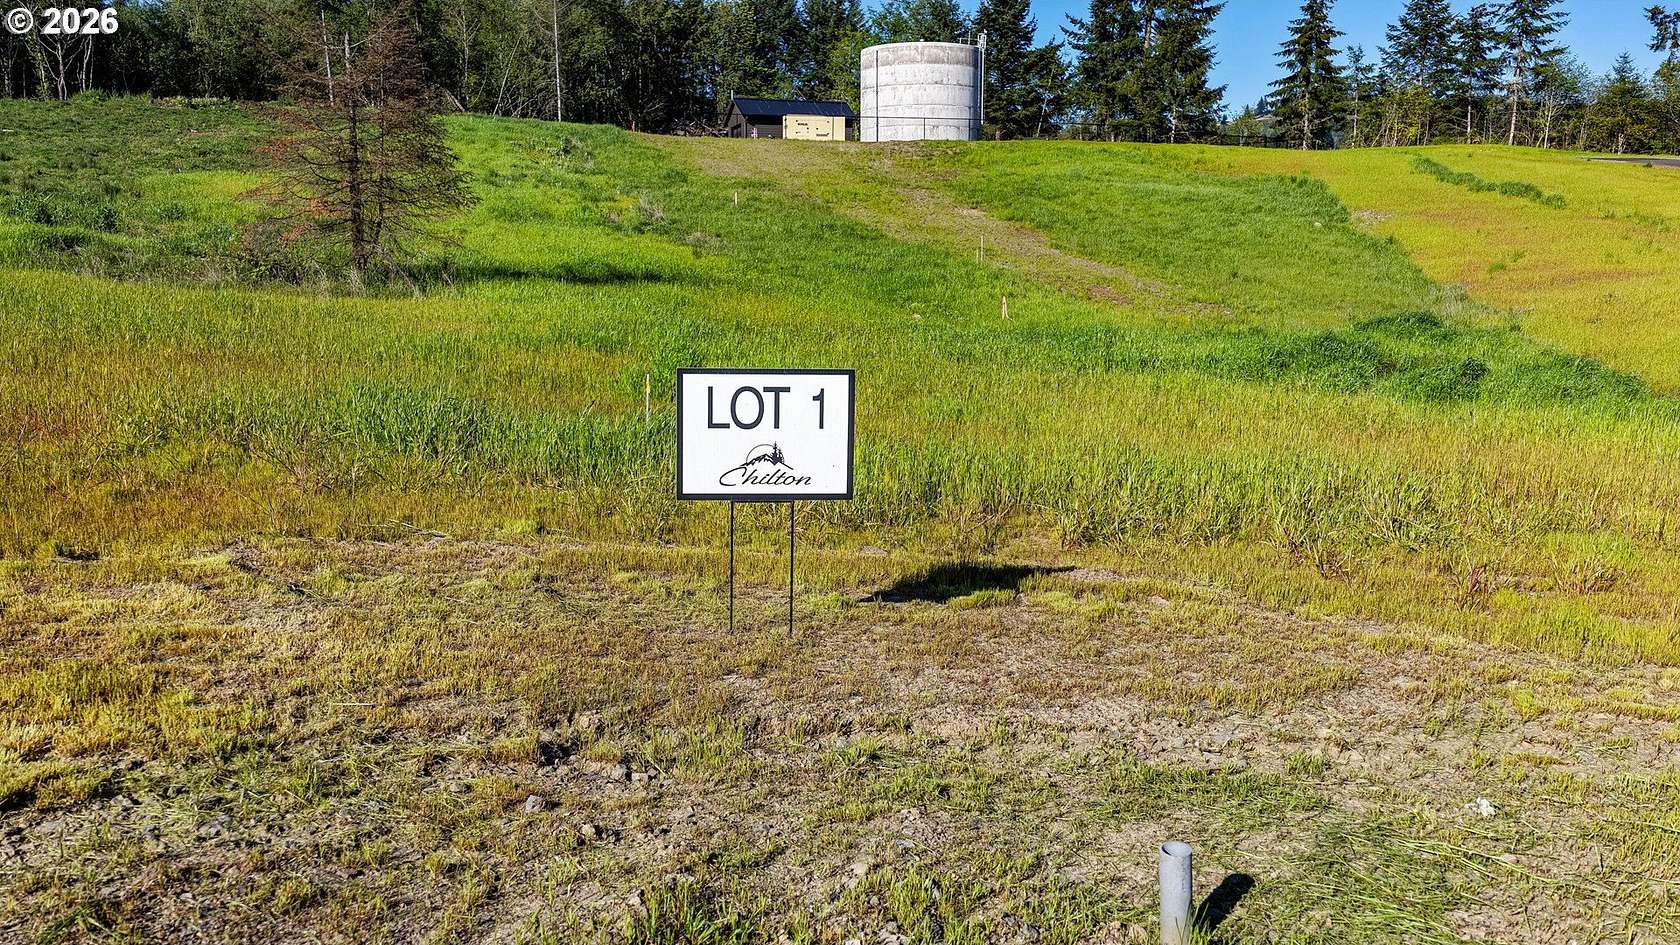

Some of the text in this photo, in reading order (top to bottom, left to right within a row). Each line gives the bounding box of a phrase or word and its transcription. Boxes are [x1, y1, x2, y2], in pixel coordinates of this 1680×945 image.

[707, 385, 825, 430] LOT 1
[718, 466, 812, 487] Chilton
